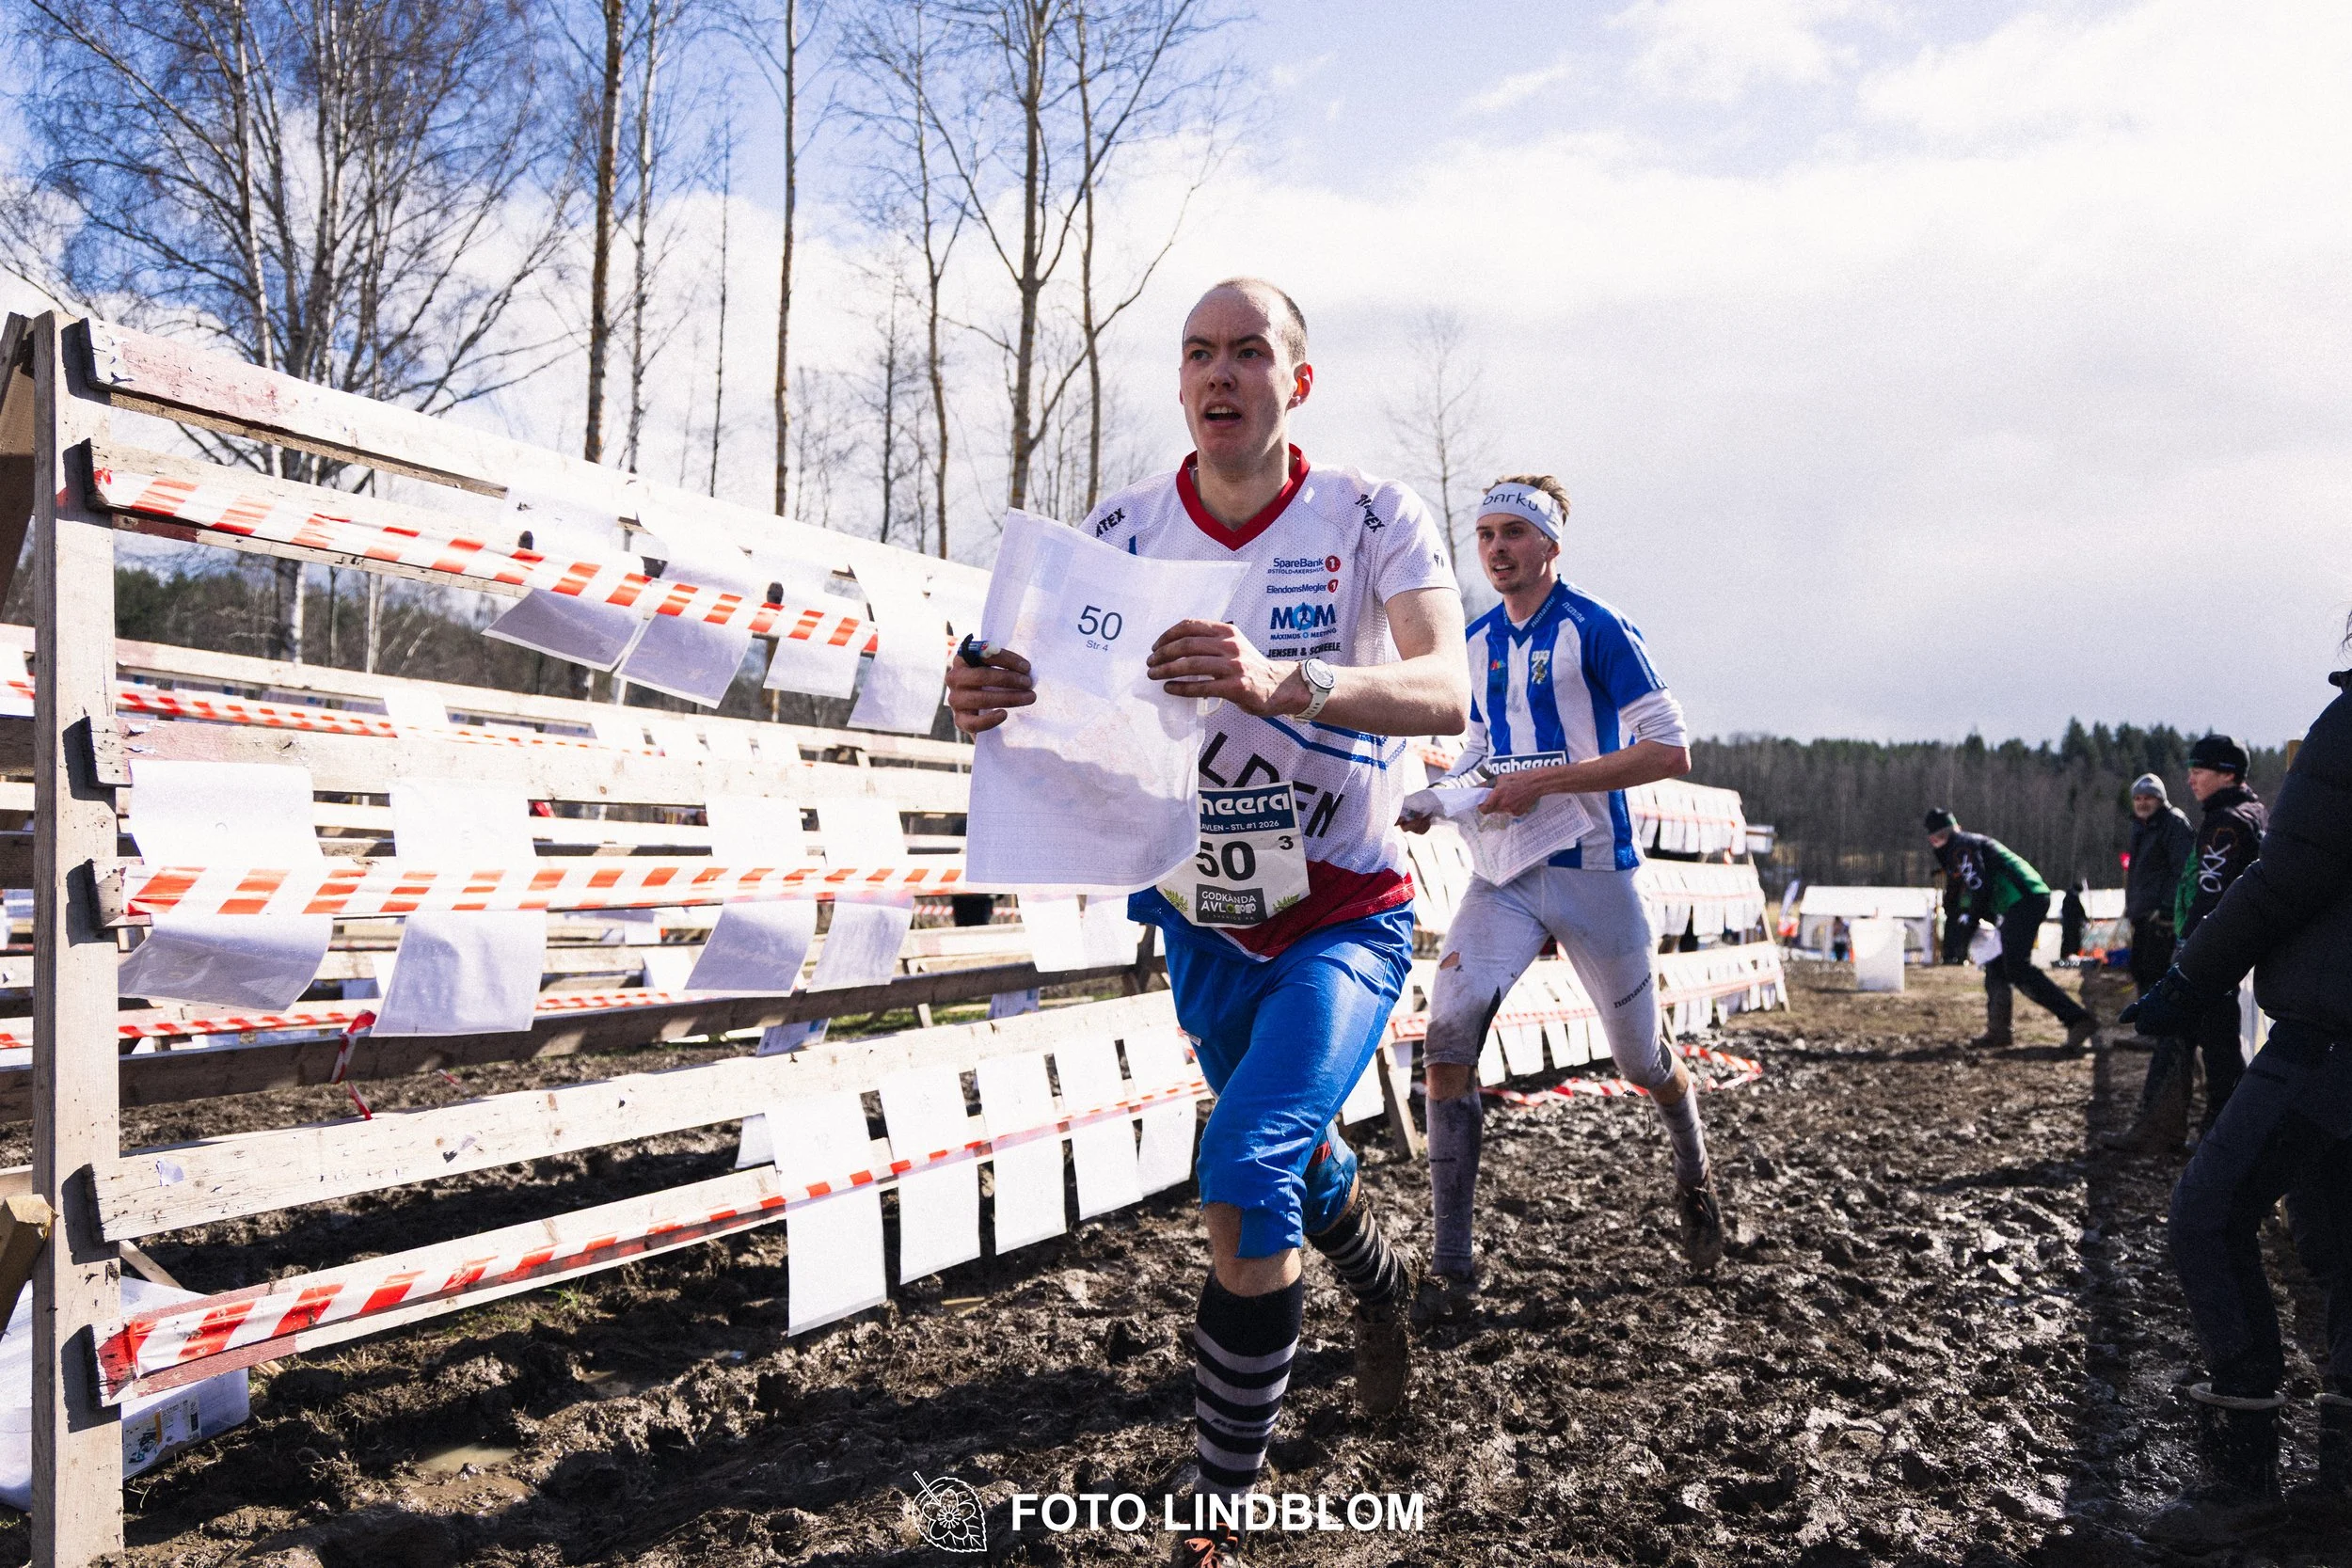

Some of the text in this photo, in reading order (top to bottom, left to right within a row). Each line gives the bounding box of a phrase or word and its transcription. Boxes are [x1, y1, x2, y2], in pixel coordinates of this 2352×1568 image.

[1273, 557, 1324, 569] SpareBank
[1266, 583, 1327, 594] EiendomsMegler
[1077, 605, 1122, 641] 50
[1270, 602, 1337, 630] MOM
[1086, 639, 1101, 650] Str
[1266, 641, 1341, 658] JENSEN & SCHEELE
[1200, 823, 1224, 832] AVLEN
[1258, 819, 1279, 829] 2026
[1278, 835, 1295, 850] 3
[1195, 840, 1256, 881] 50
[2199, 843, 2232, 894] OKK
